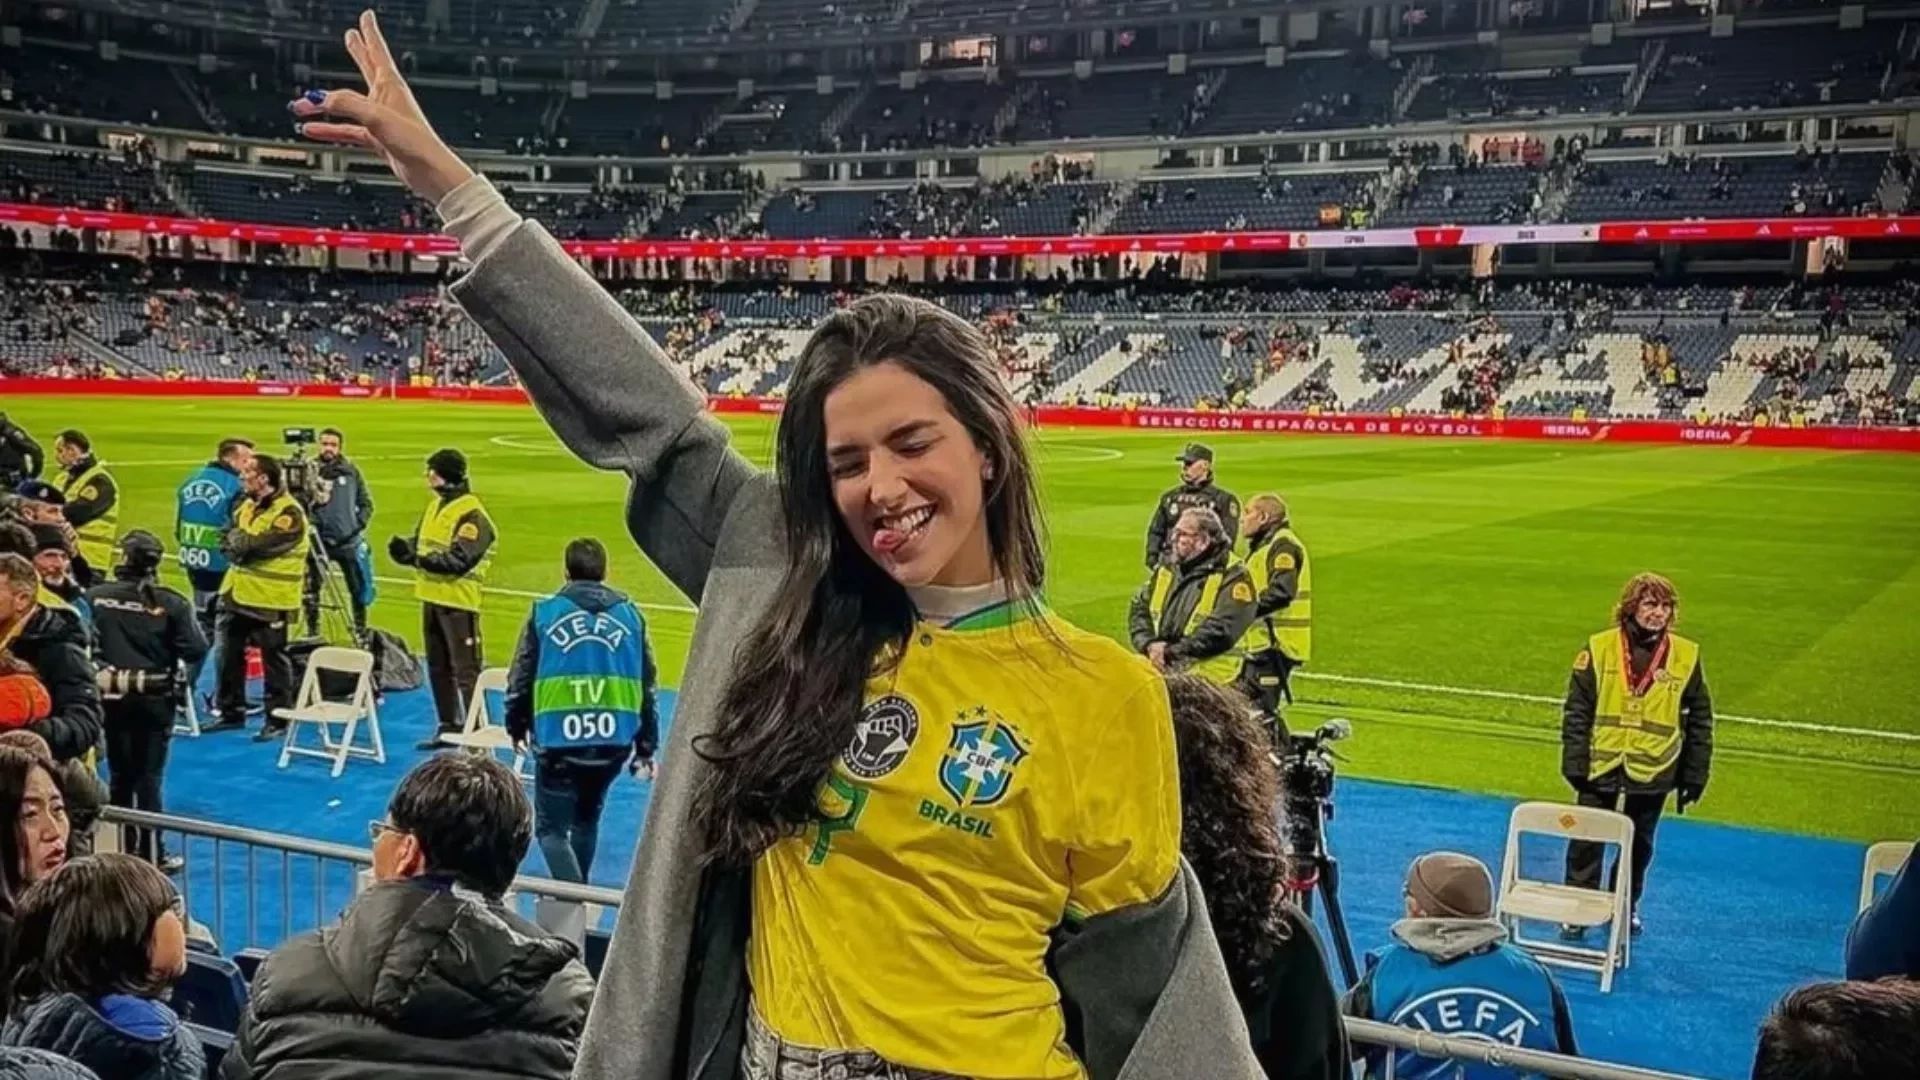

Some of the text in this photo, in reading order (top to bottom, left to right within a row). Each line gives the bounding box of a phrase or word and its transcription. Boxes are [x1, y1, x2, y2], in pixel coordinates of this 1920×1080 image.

[1138, 415, 1482, 435] SELECCIÓN ESPAÑOLA DE FÚTBOL
[183, 484, 221, 506] UEFA
[182, 523, 205, 543] TV
[550, 617, 624, 647] UEFA
[569, 679, 605, 704] TV
[562, 712, 616, 740] 050
[967, 752, 995, 768] CBF
[919, 799, 994, 838] BRASIL
